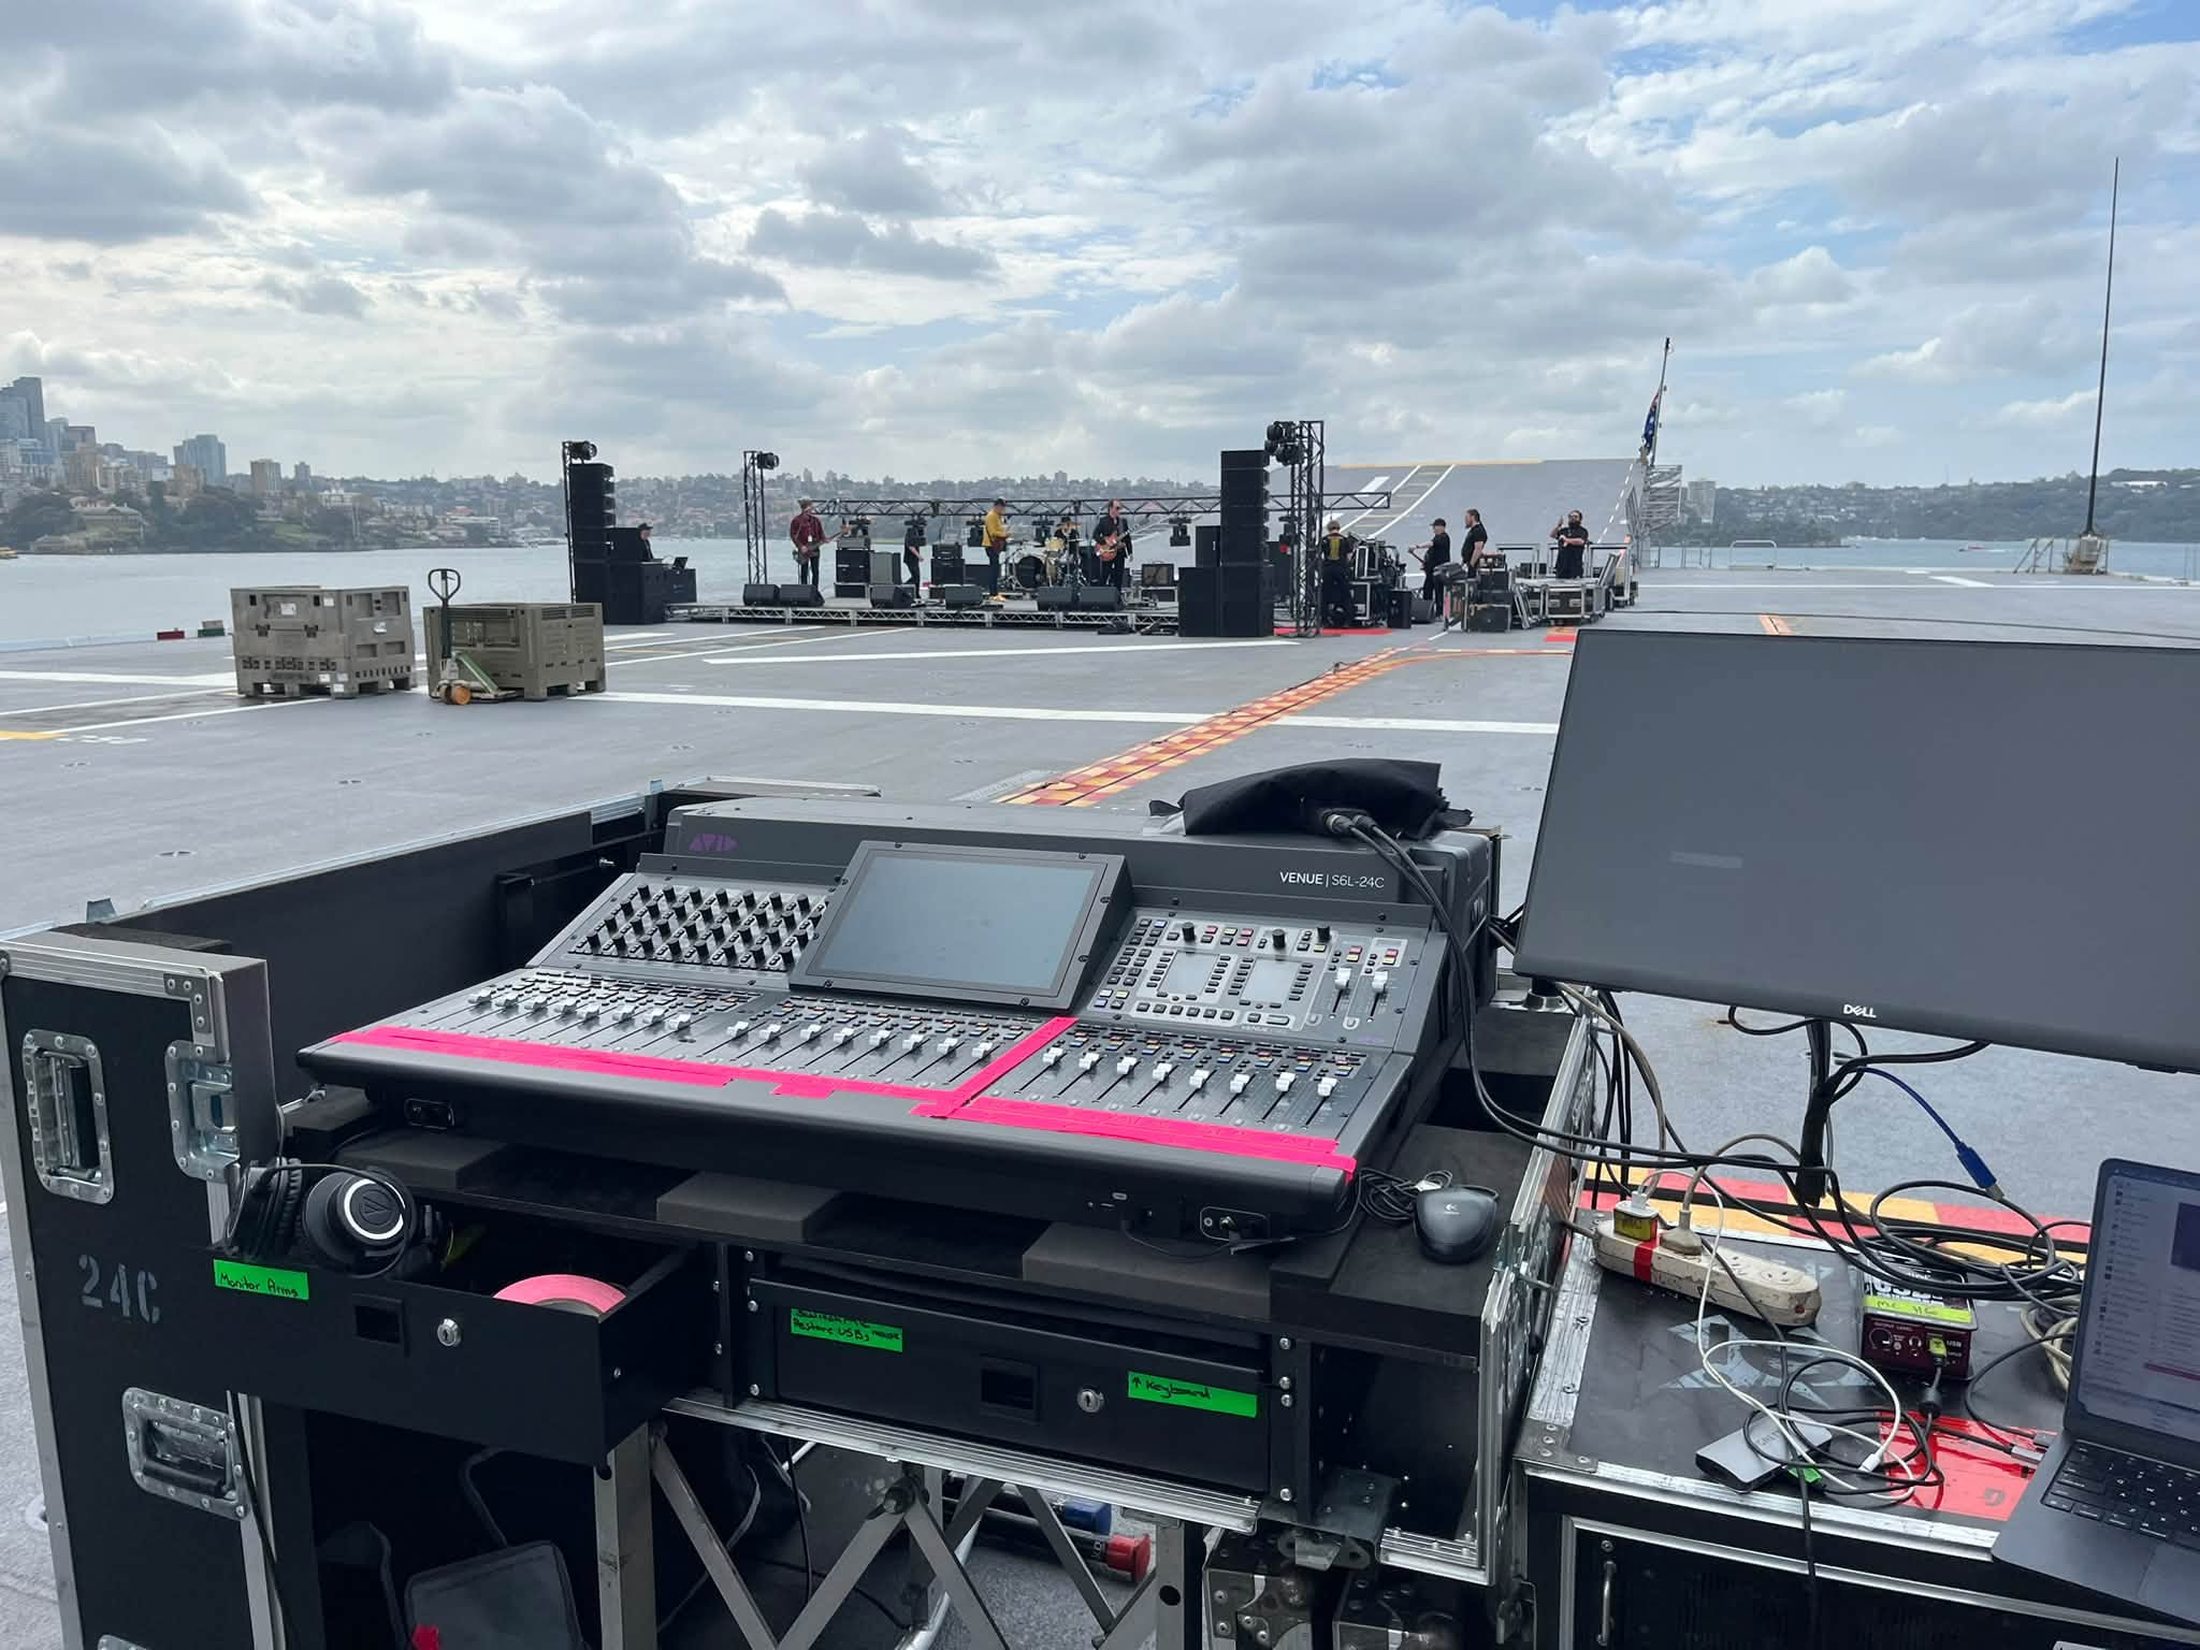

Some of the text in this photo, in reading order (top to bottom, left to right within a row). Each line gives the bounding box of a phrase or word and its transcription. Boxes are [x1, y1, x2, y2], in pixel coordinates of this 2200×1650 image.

[1280, 871, 1385, 889] VENUE S6L-24C
[1843, 1003, 1877, 1018] DELL
[78, 1253, 161, 1324] 24C
[219, 1272, 299, 1298] Monitor Arms
